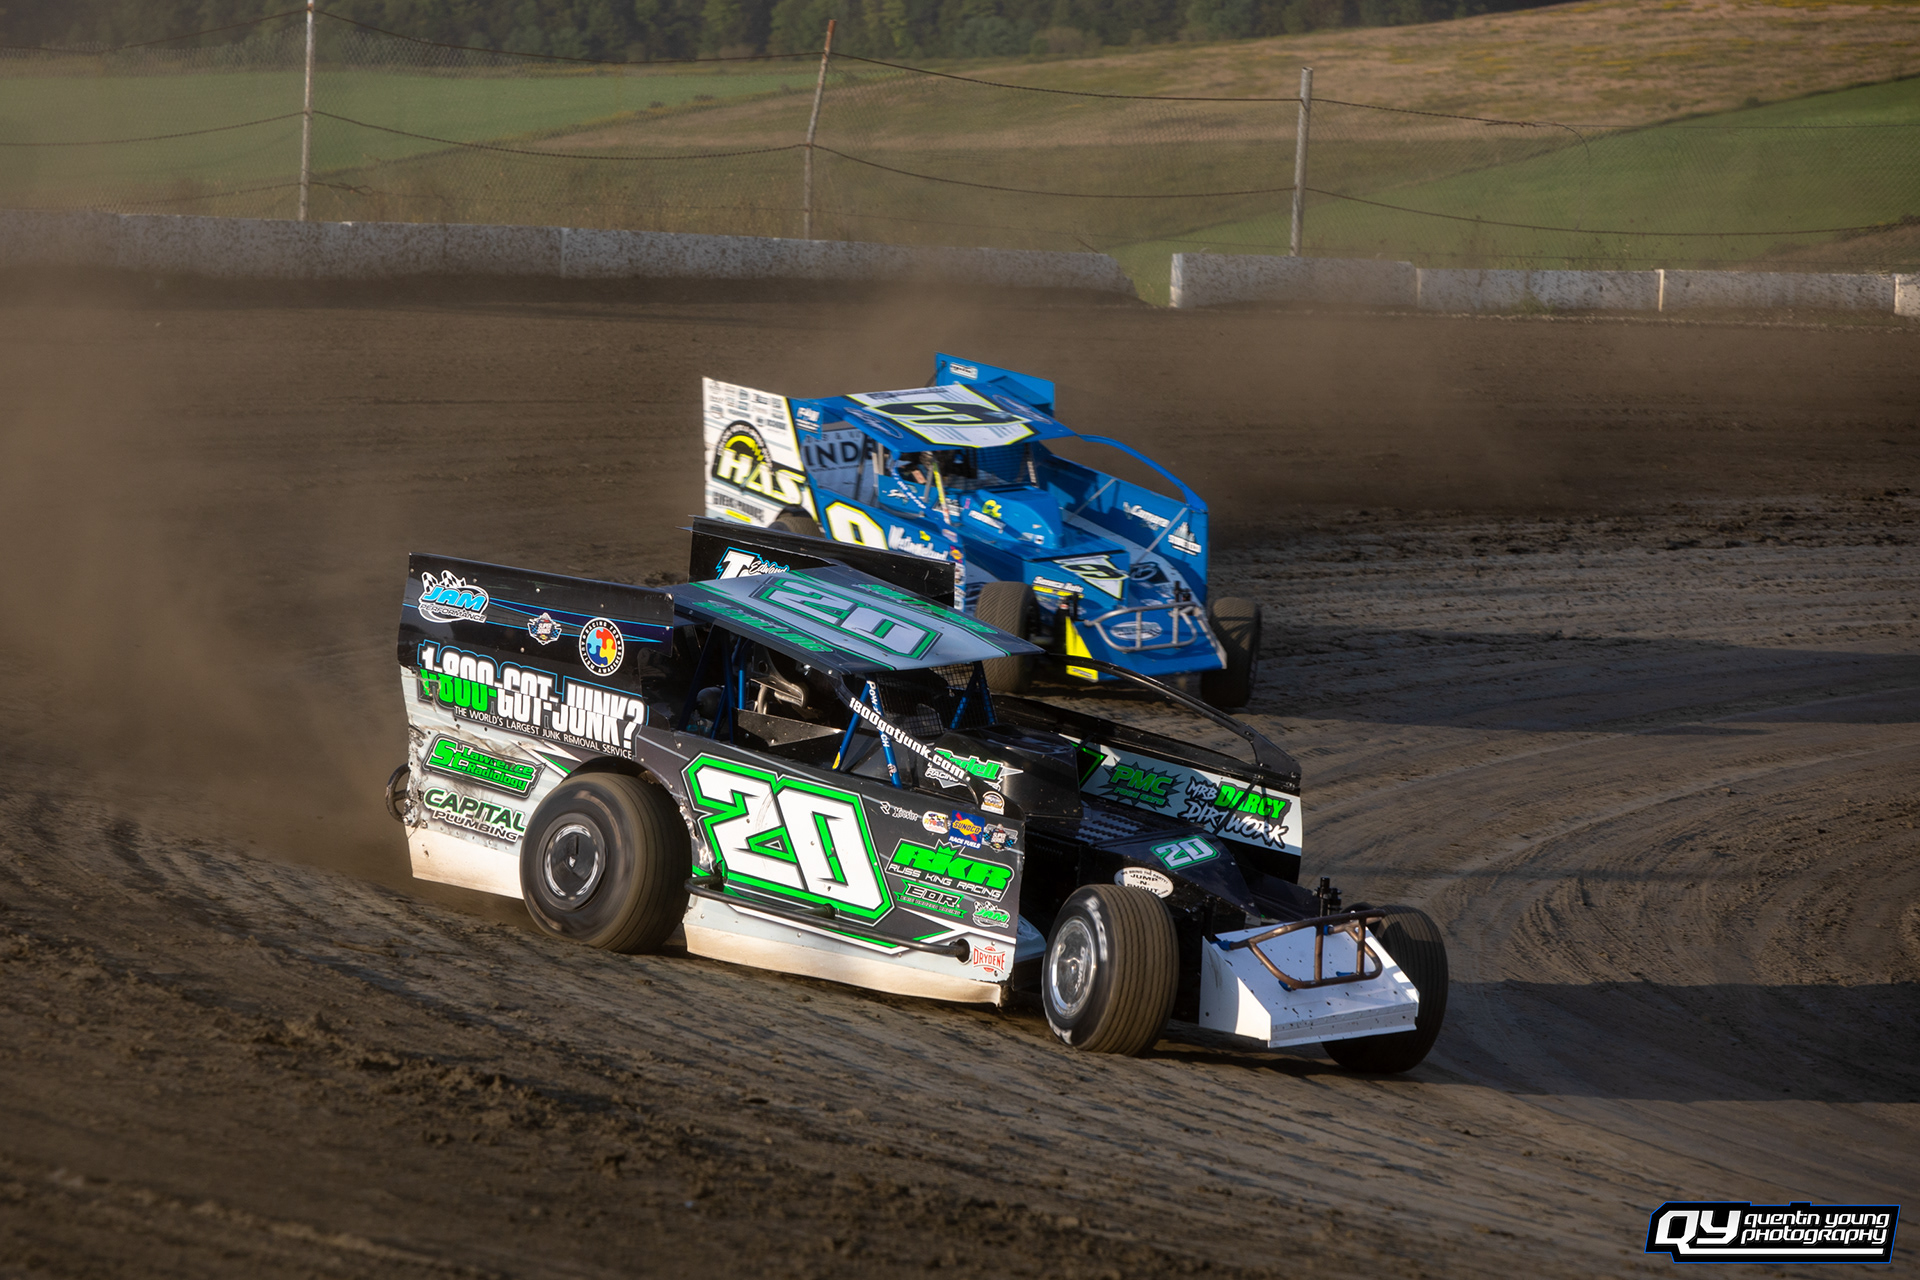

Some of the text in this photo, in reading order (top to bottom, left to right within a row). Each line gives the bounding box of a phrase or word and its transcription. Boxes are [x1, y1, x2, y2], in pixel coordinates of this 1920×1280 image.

[420, 603, 487, 622] PERFORMANCE
[422, 586, 486, 611] JAM
[757, 578, 937, 657] 20
[454, 706, 633, 760] THE WORLD'S LARGEST JUNK REMOVAL SERVICE
[849, 697, 965, 779] 1800gotjunk.com
[463, 747, 535, 776] Lawrence
[467, 764, 528, 791] Radiology
[1110, 765, 1173, 795] PMC
[424, 789, 527, 832] CAPITAL
[1188, 779, 1286, 819] MRB DARCY
[432, 810, 519, 842] PLUMBING
[692, 760, 889, 915] 20
[953, 821, 981, 834] SUNOCO
[948, 835, 981, 849] RACE FUELS
[1153, 837, 1217, 868] 20
[888, 863, 1002, 898] RUSS KING RACING
[974, 909, 1009, 922] JAM
[973, 948, 1006, 970] DRYDENE
